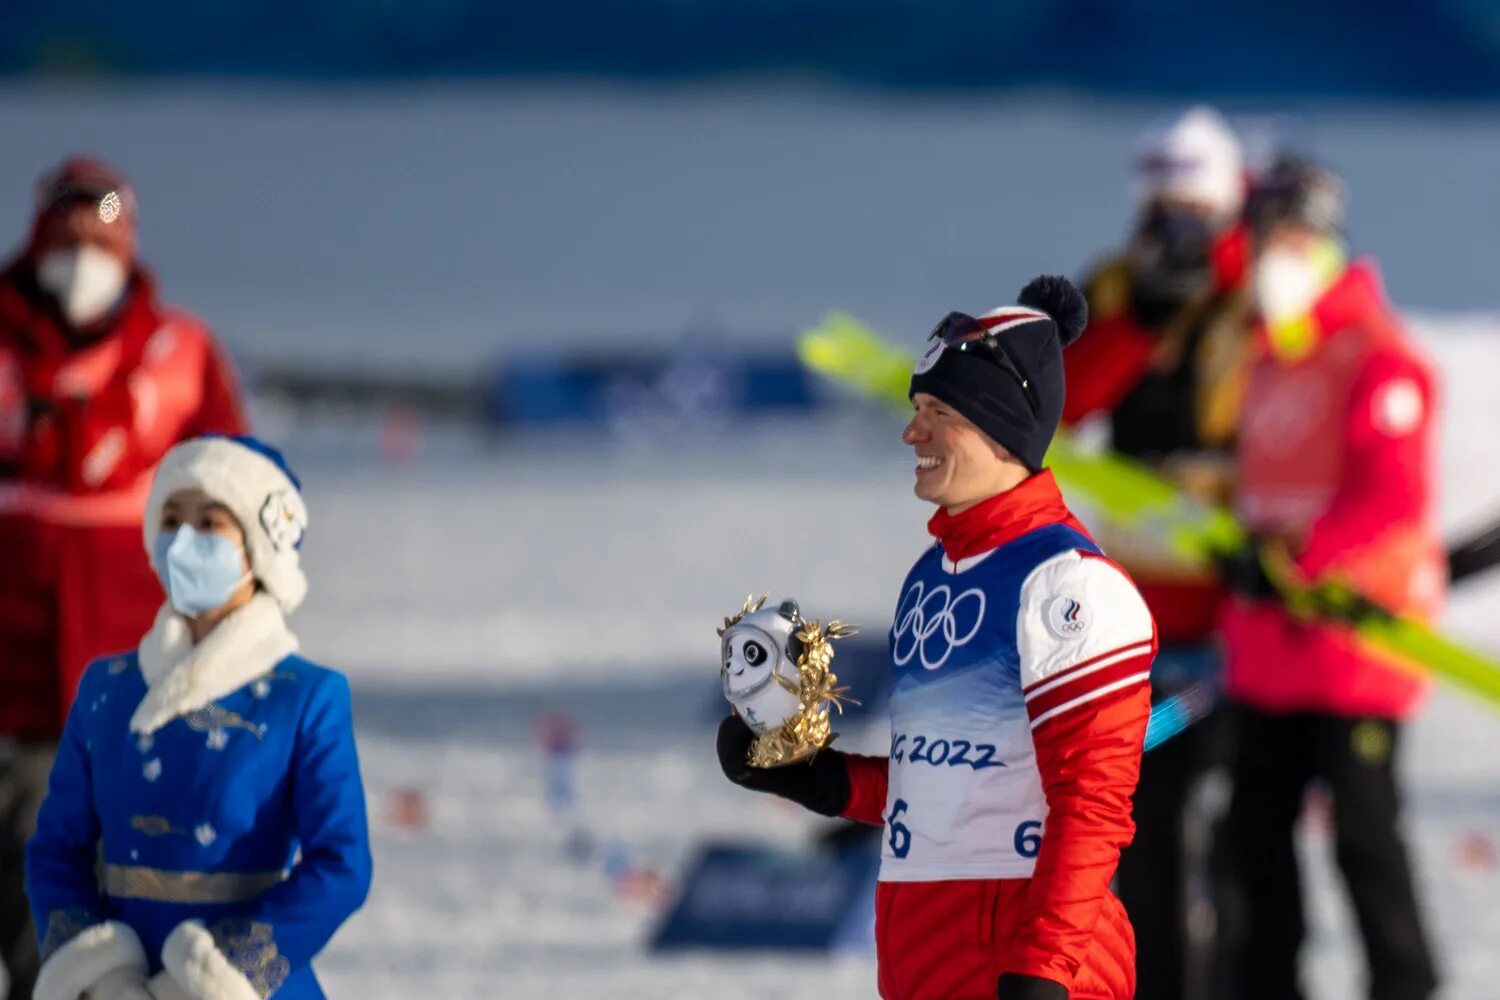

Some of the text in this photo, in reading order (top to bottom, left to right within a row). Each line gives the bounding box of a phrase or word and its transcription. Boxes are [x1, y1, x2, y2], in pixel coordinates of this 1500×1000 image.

[909, 735, 1008, 771] 2022
[889, 798, 911, 860] 6
[1013, 820, 1043, 859] 6
